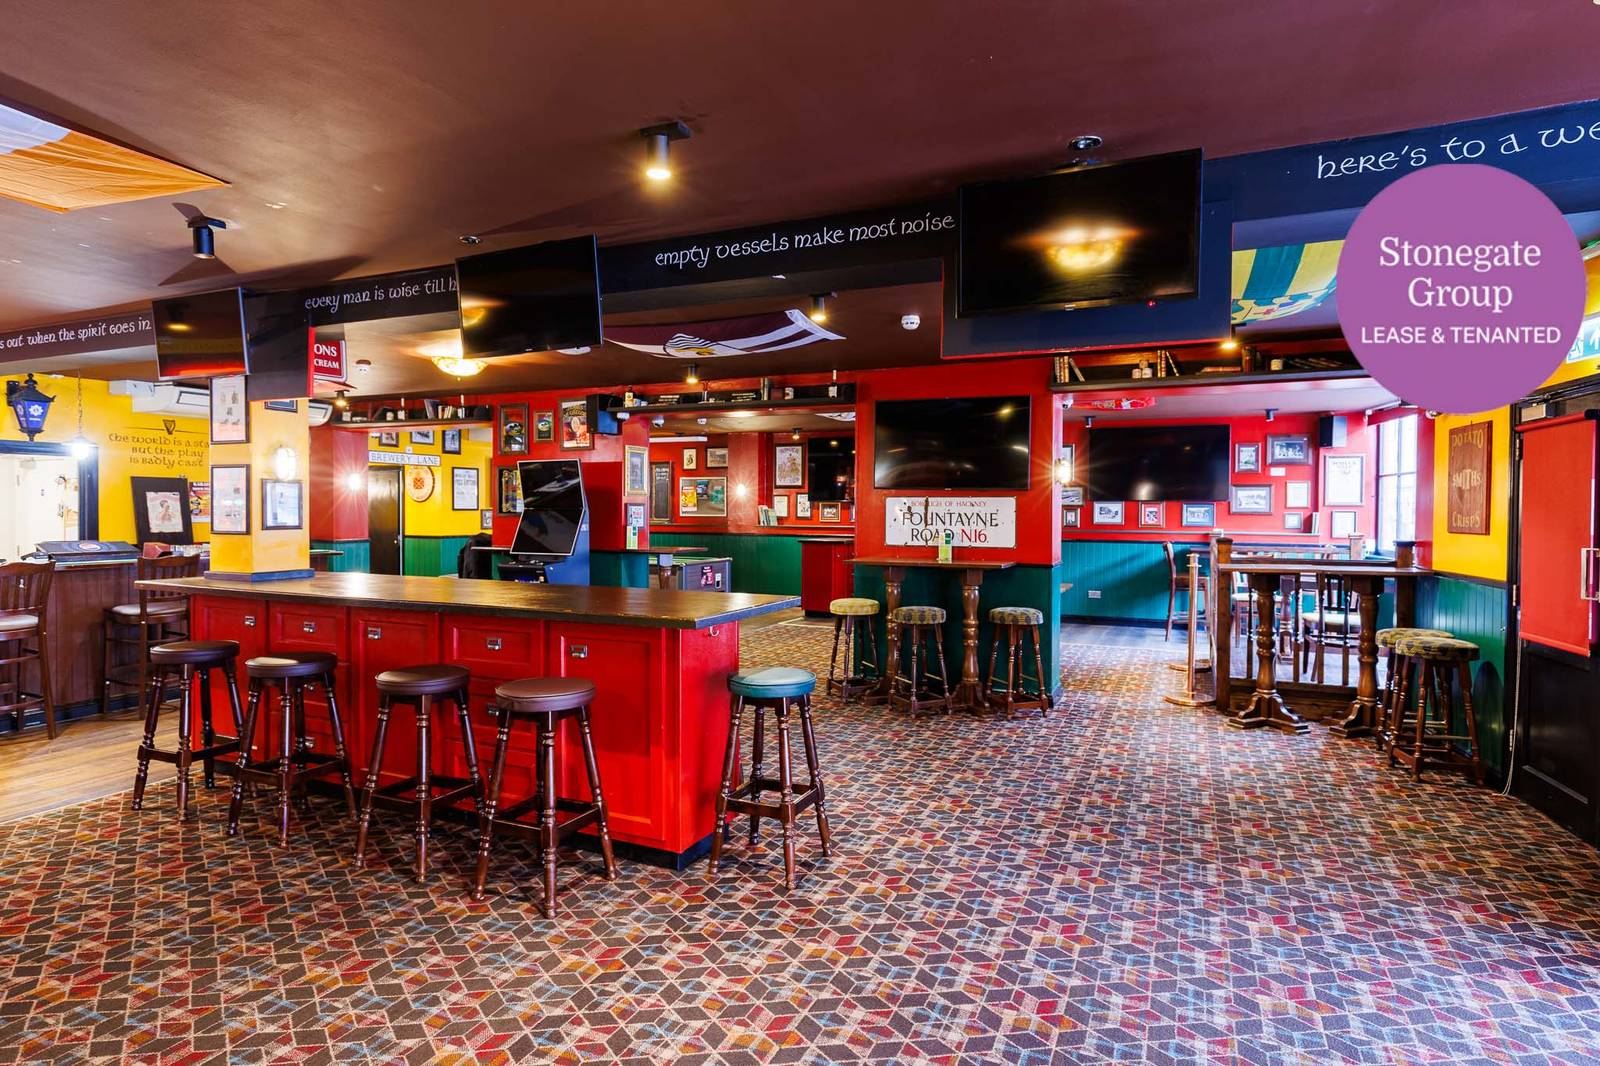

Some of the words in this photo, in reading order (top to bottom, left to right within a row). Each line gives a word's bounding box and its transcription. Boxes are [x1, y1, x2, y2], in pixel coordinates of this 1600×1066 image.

[1317, 145, 1428, 179] here's
[1440, 136, 1486, 162] to
[1499, 133, 1529, 155] a
[655, 246, 710, 269] empty
[716, 232, 789, 259] vessels
[794, 226, 846, 249] make
[849, 218, 898, 242] most
[901, 212, 955, 234] noise
[304, 294, 340, 313] every
[343, 290, 371, 304] man
[374, 285, 385, 300] is
[388, 282, 421, 297] wise
[424, 278, 446, 293] till
[6, 334, 24, 348] out
[26, 331, 57, 346] when
[59, 327, 76, 342] the
[78, 322, 108, 342] spirit
[109, 322, 136, 335] goes
[138, 316, 152, 331] in
[313, 343, 337, 357] ONS
[313, 358, 340, 370] CREAM
[108, 432, 129, 442] the
[131, 434, 171, 445] world
[173, 436, 182, 448] is
[184, 439, 191, 447] a
[1452, 428, 1484, 449] POTATO
[154, 447, 175, 456] the
[177, 448, 204, 459] play
[370, 453, 411, 463] BREWERY
[417, 456, 438, 465] LANE
[129, 456, 140, 465] is
[177, 459, 205, 467] cast
[1452, 469, 1481, 490] SMITHS
[902, 511, 999, 527] FOUNTAYNE
[1452, 511, 1481, 528] CRISPS
[911, 528, 955, 542] ROAD
